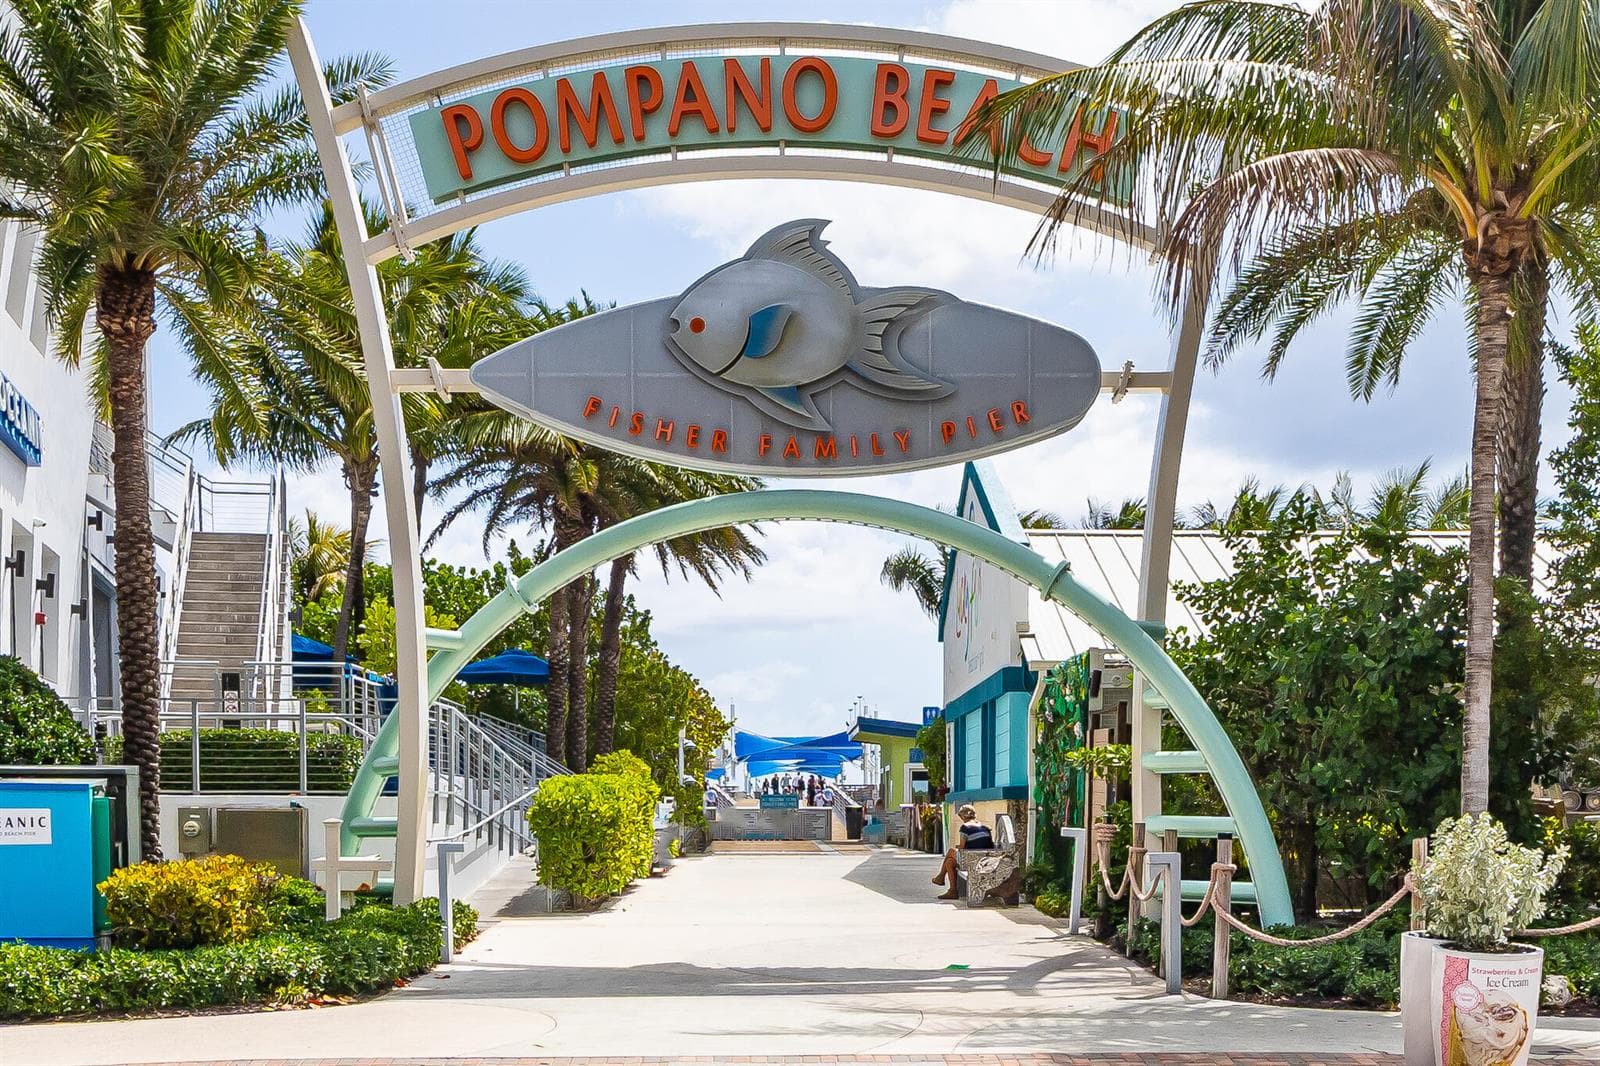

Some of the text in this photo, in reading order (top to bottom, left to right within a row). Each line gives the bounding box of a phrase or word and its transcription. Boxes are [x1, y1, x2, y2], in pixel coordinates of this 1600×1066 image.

[440, 57, 838, 180] POMPANO
[583, 396, 1031, 460] FISHER FAMILY PIER
[0, 816, 46, 828] ANIC
[1472, 967, 1516, 976] Strawberries
[1486, 977, 1529, 987] Ice Cream
